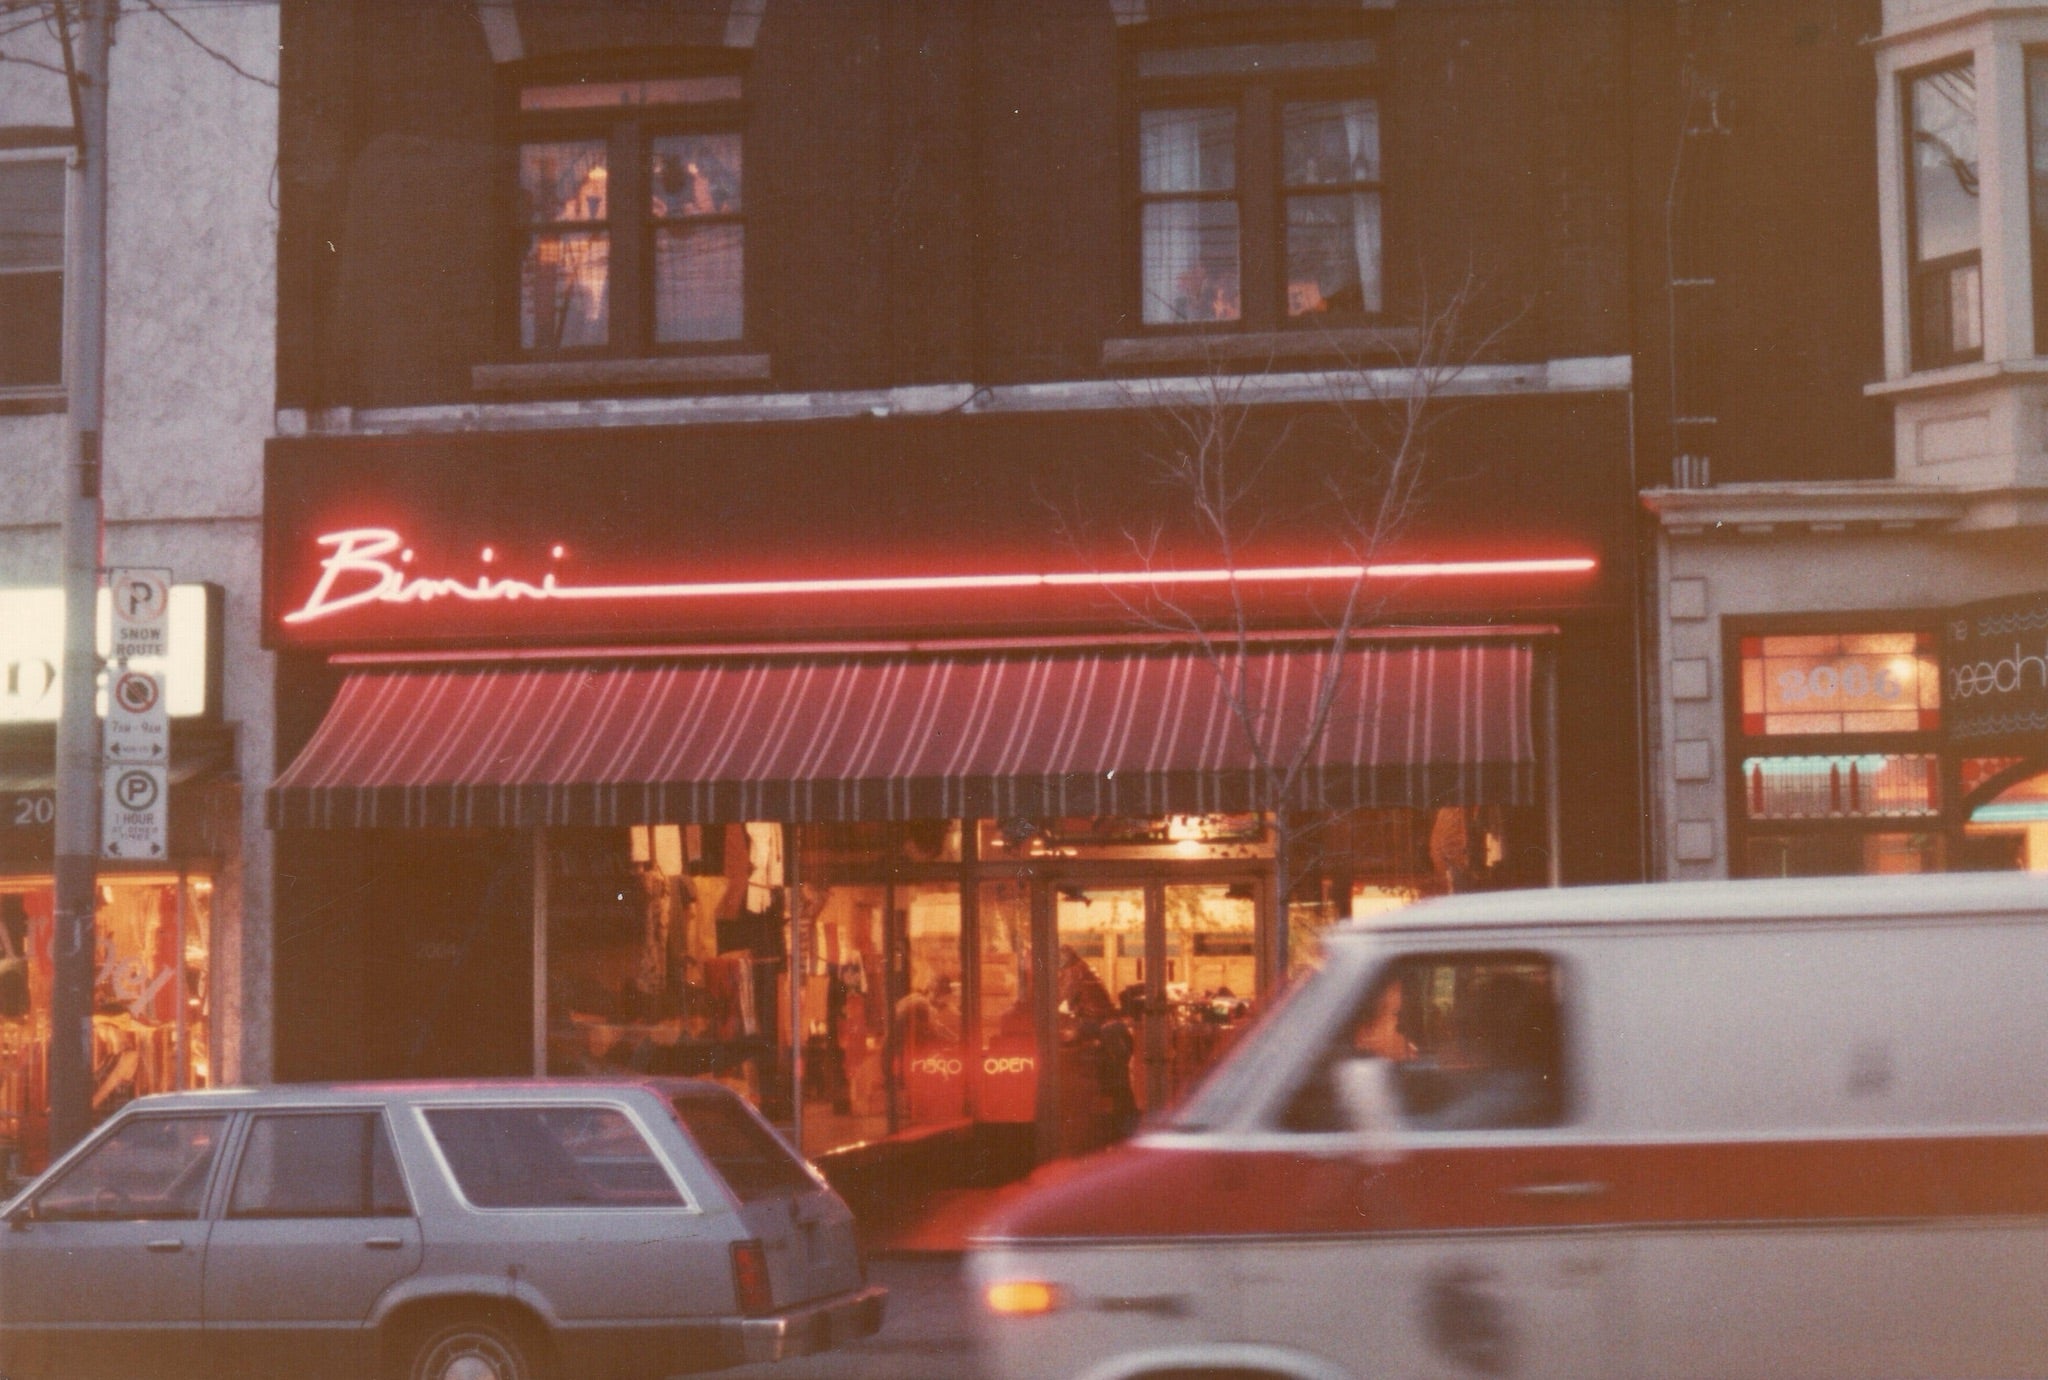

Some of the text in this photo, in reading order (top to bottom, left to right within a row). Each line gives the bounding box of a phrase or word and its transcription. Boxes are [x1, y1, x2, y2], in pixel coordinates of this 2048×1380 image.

[283, 529, 565, 623] Bimini
[120, 627, 161, 640] SNOW
[116, 643, 163, 656] ROUTE
[1778, 664, 1902, 704] 2006
[128, 778, 148, 801] P
[123, 813, 154, 825] HOUR
